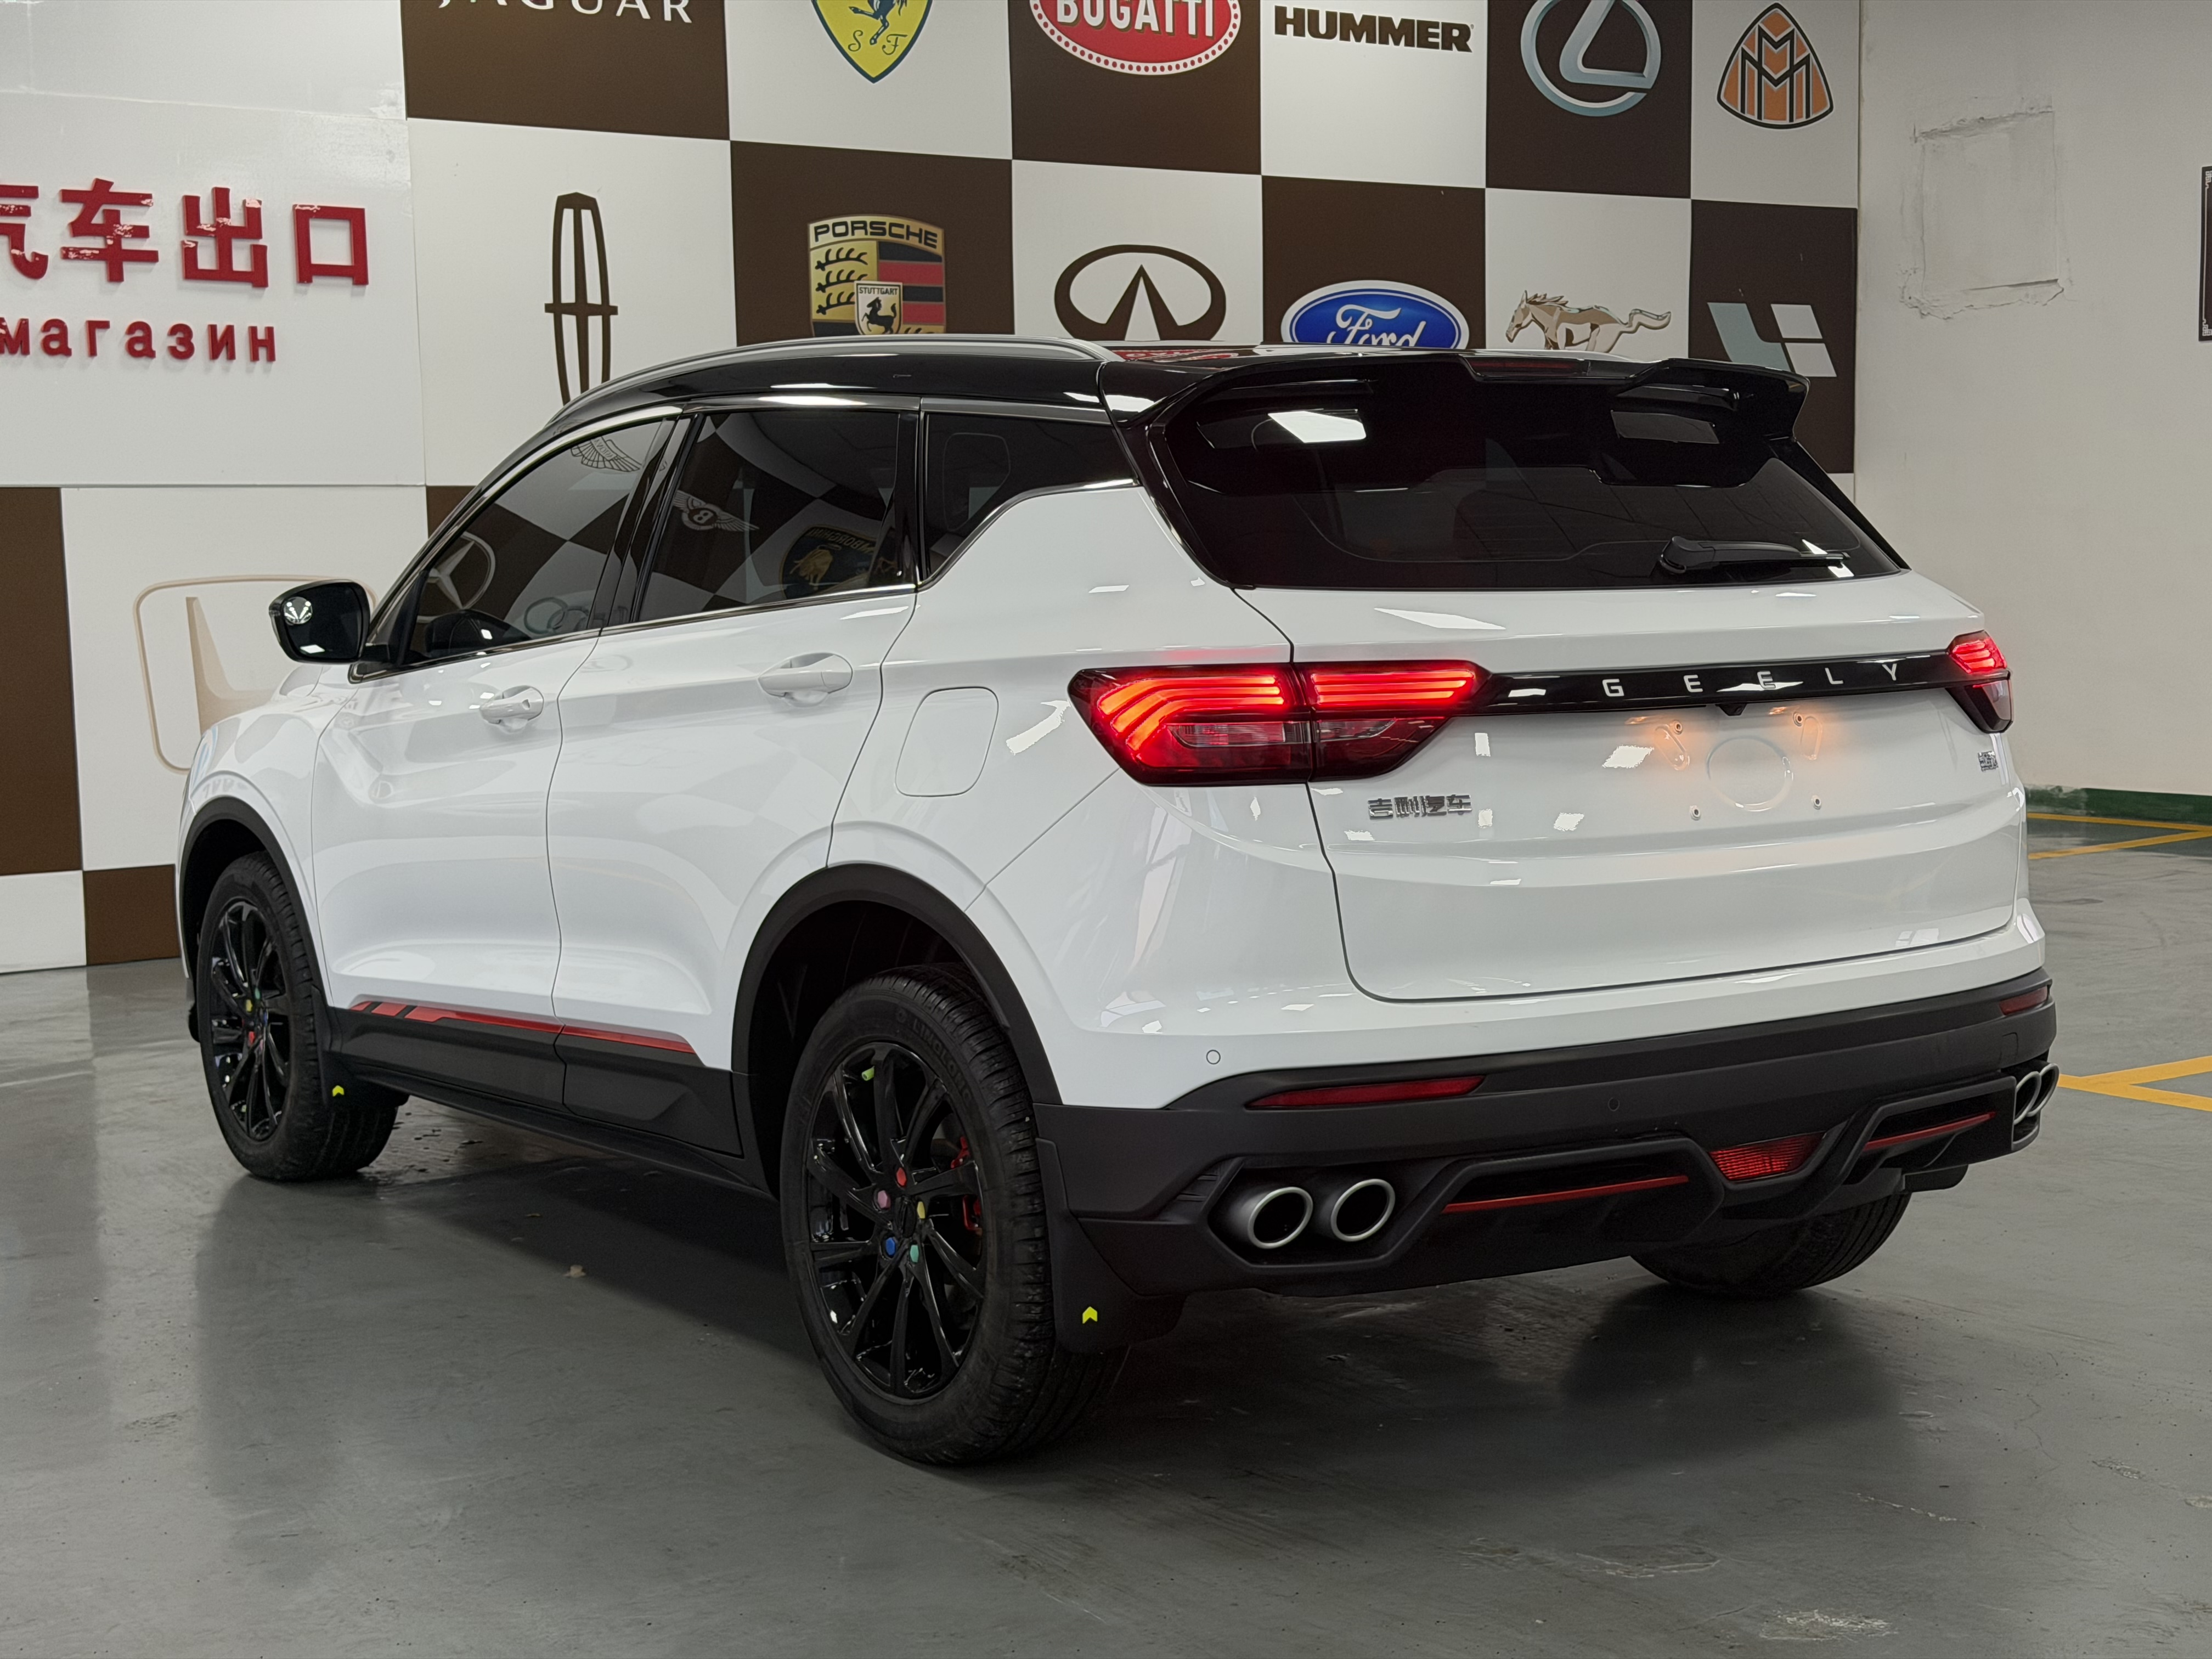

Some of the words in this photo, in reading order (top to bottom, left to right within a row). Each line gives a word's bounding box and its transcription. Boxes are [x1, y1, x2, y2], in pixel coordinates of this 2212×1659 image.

[1274, 5, 1472, 53] HUMMER
[814, 220, 938, 249] PORSCHE
[859, 286, 898, 296] STUTTGART
[1602, 663, 1898, 697] GEELY
